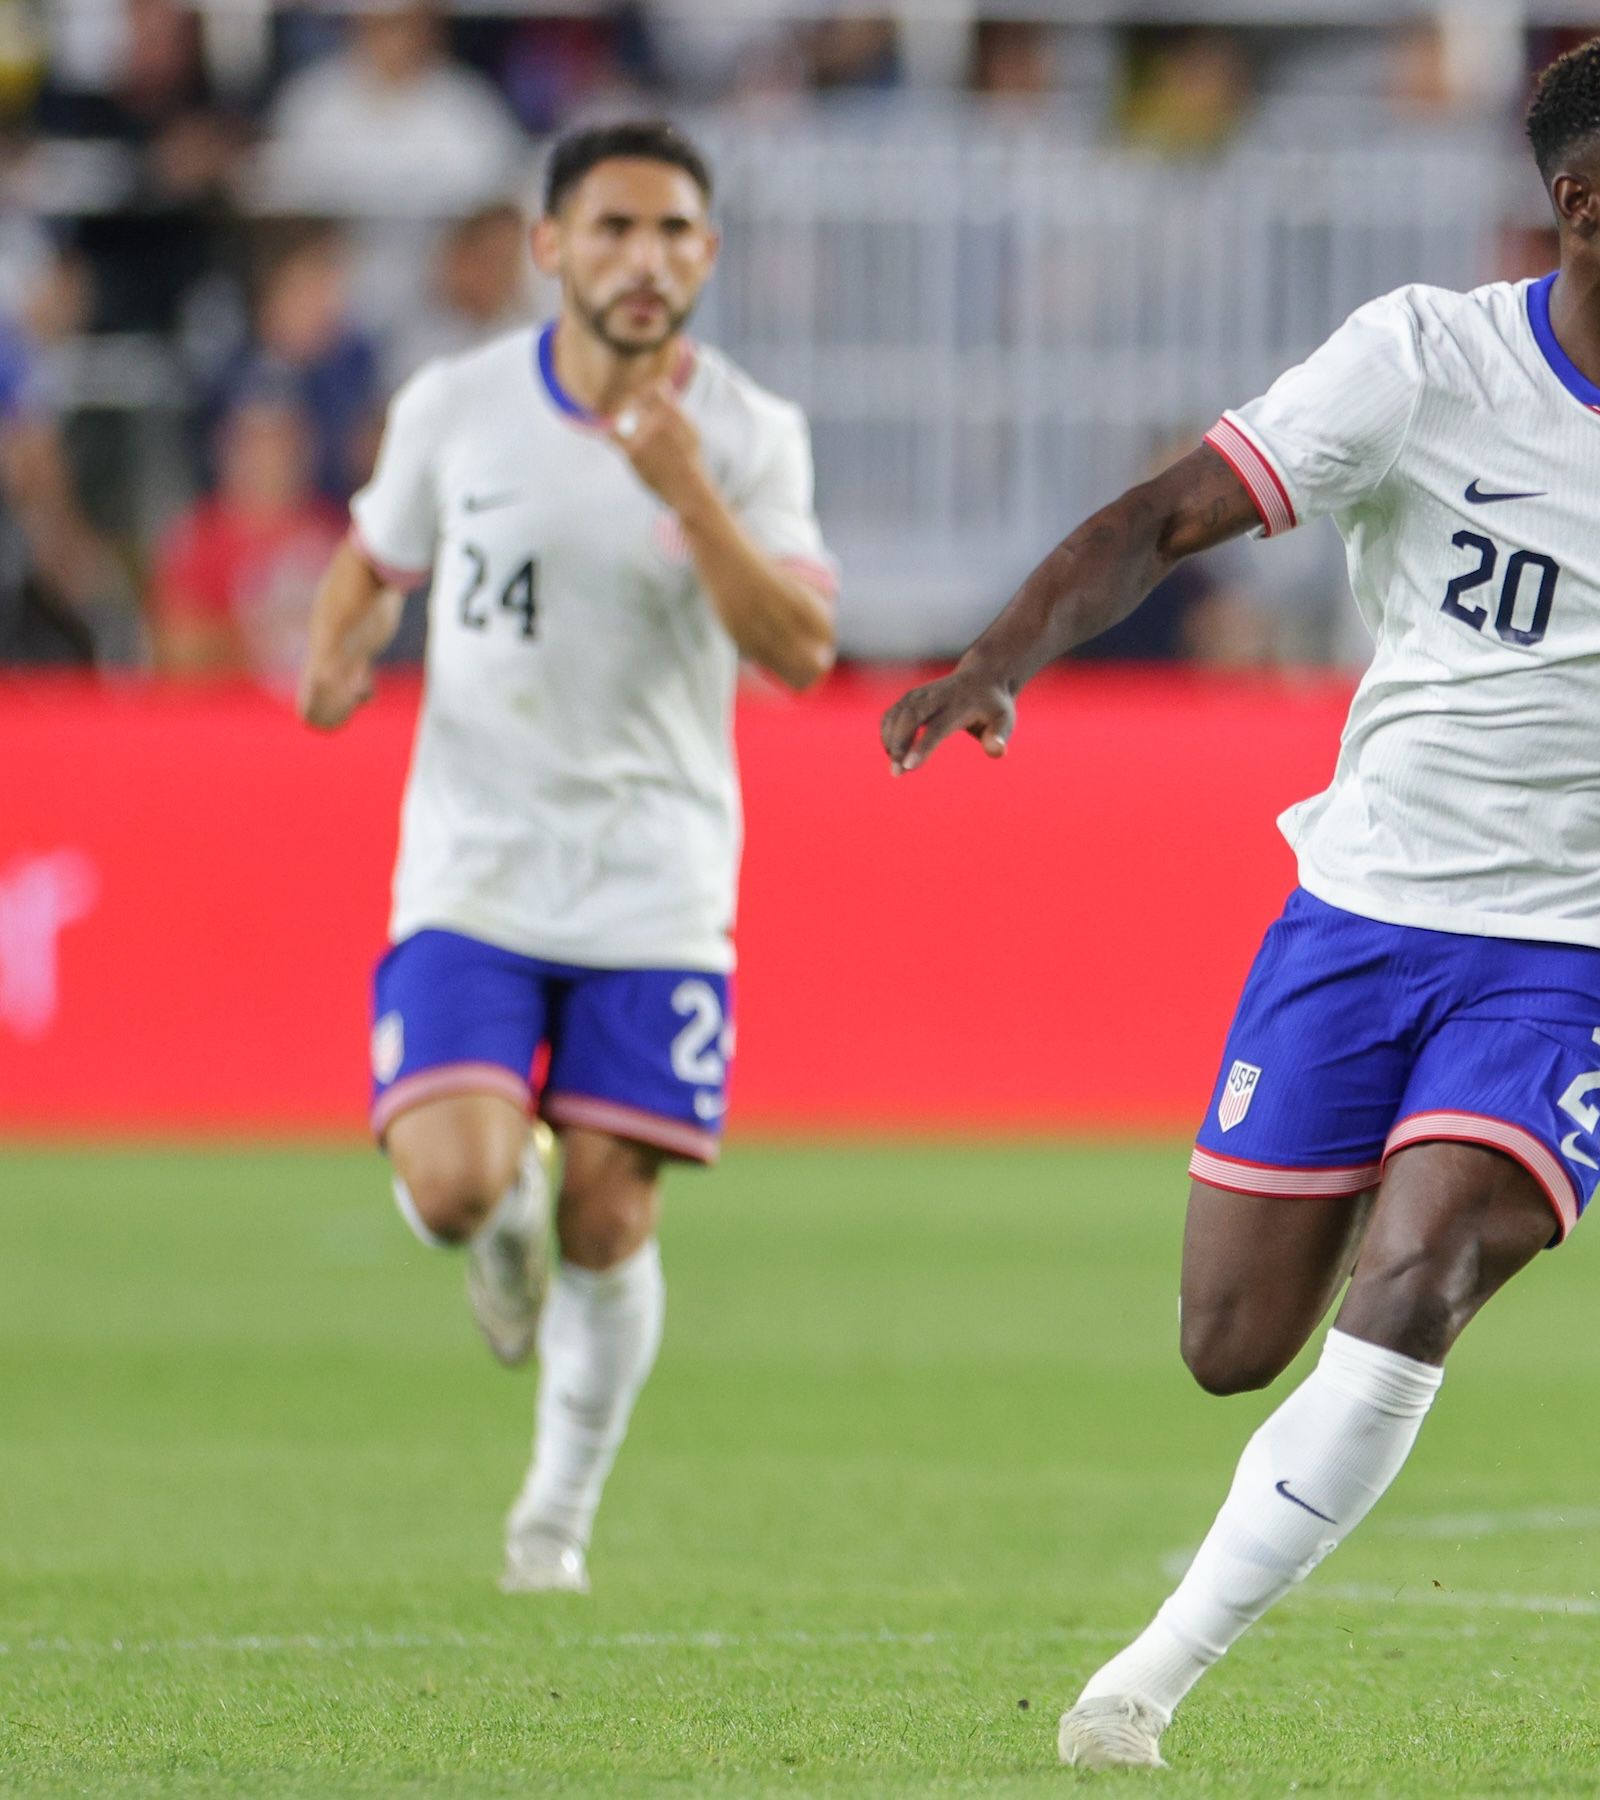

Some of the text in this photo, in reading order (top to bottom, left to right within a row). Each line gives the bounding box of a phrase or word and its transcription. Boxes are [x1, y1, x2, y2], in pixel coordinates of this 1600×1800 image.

[461, 544, 537, 638] 24
[1440, 530, 1560, 647] 20
[1231, 1065, 1257, 1092] USA
